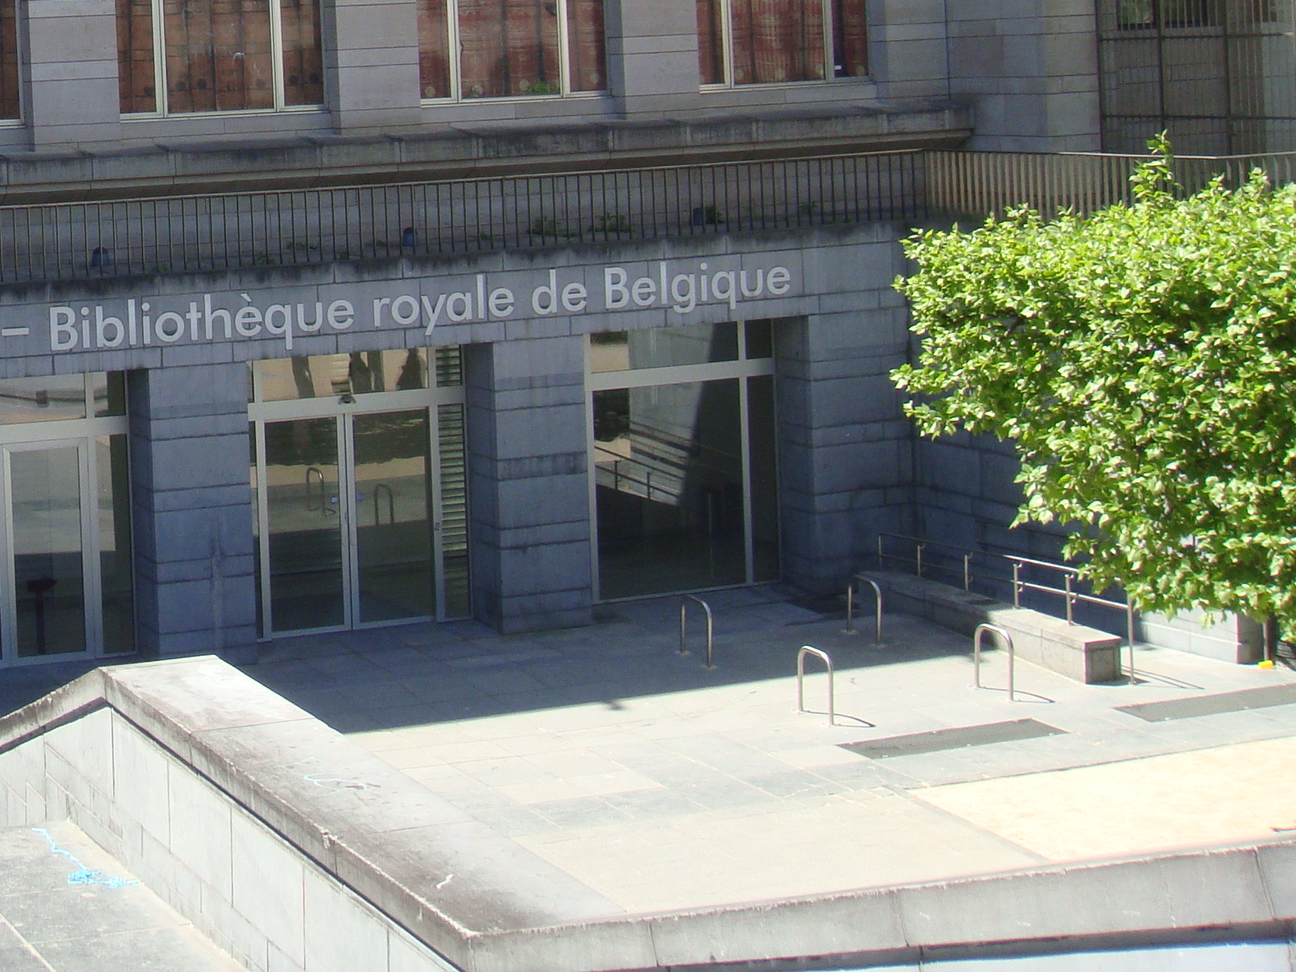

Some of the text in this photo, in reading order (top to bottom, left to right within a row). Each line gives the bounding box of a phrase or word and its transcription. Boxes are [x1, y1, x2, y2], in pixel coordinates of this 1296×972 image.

[49, 294, 355, 351] Bibliothèque
[372, 273, 515, 336] royale
[531, 269, 588, 316] de
[604, 260, 791, 314] Belgique
